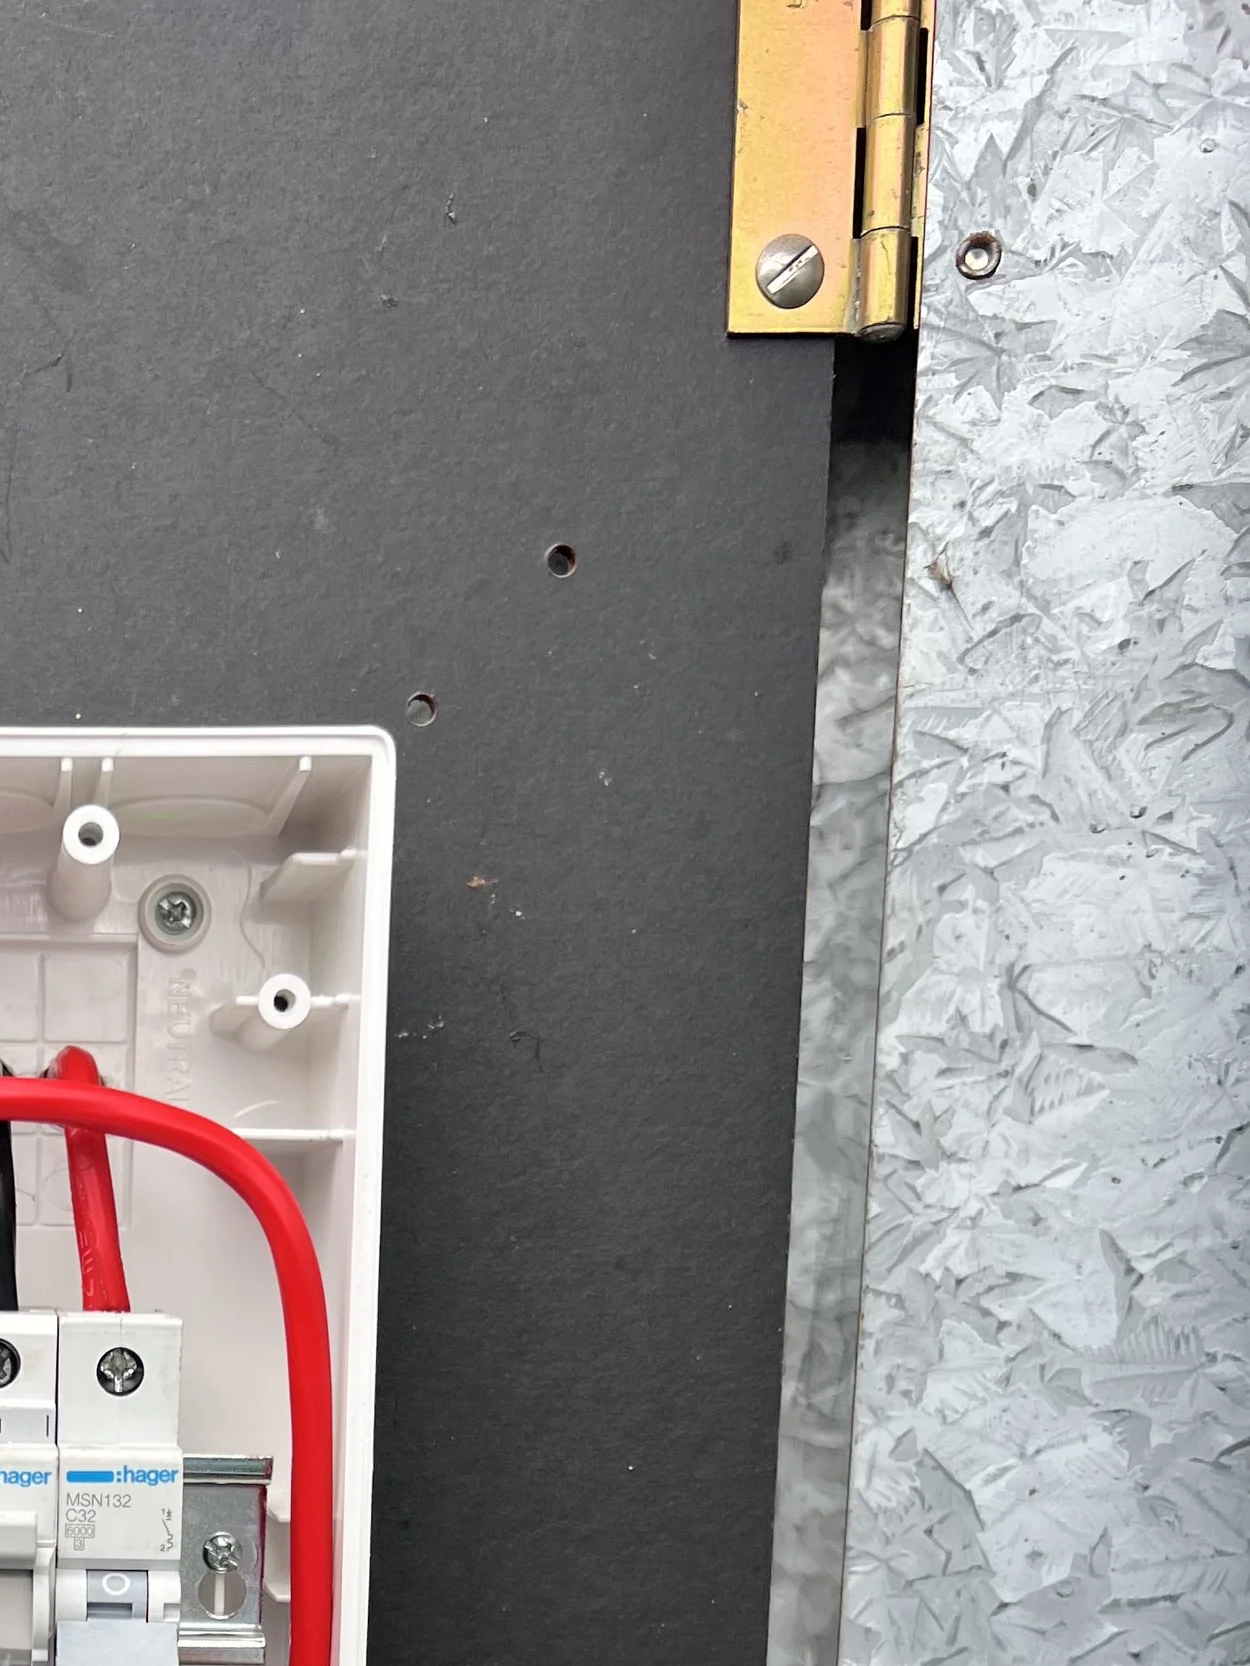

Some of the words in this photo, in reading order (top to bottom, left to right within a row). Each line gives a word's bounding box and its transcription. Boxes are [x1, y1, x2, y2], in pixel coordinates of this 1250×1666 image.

[66, 1492, 132, 1508] MSN132
[65, 1508, 97, 1523] C32
[67, 1526, 94, 1536] 6000
